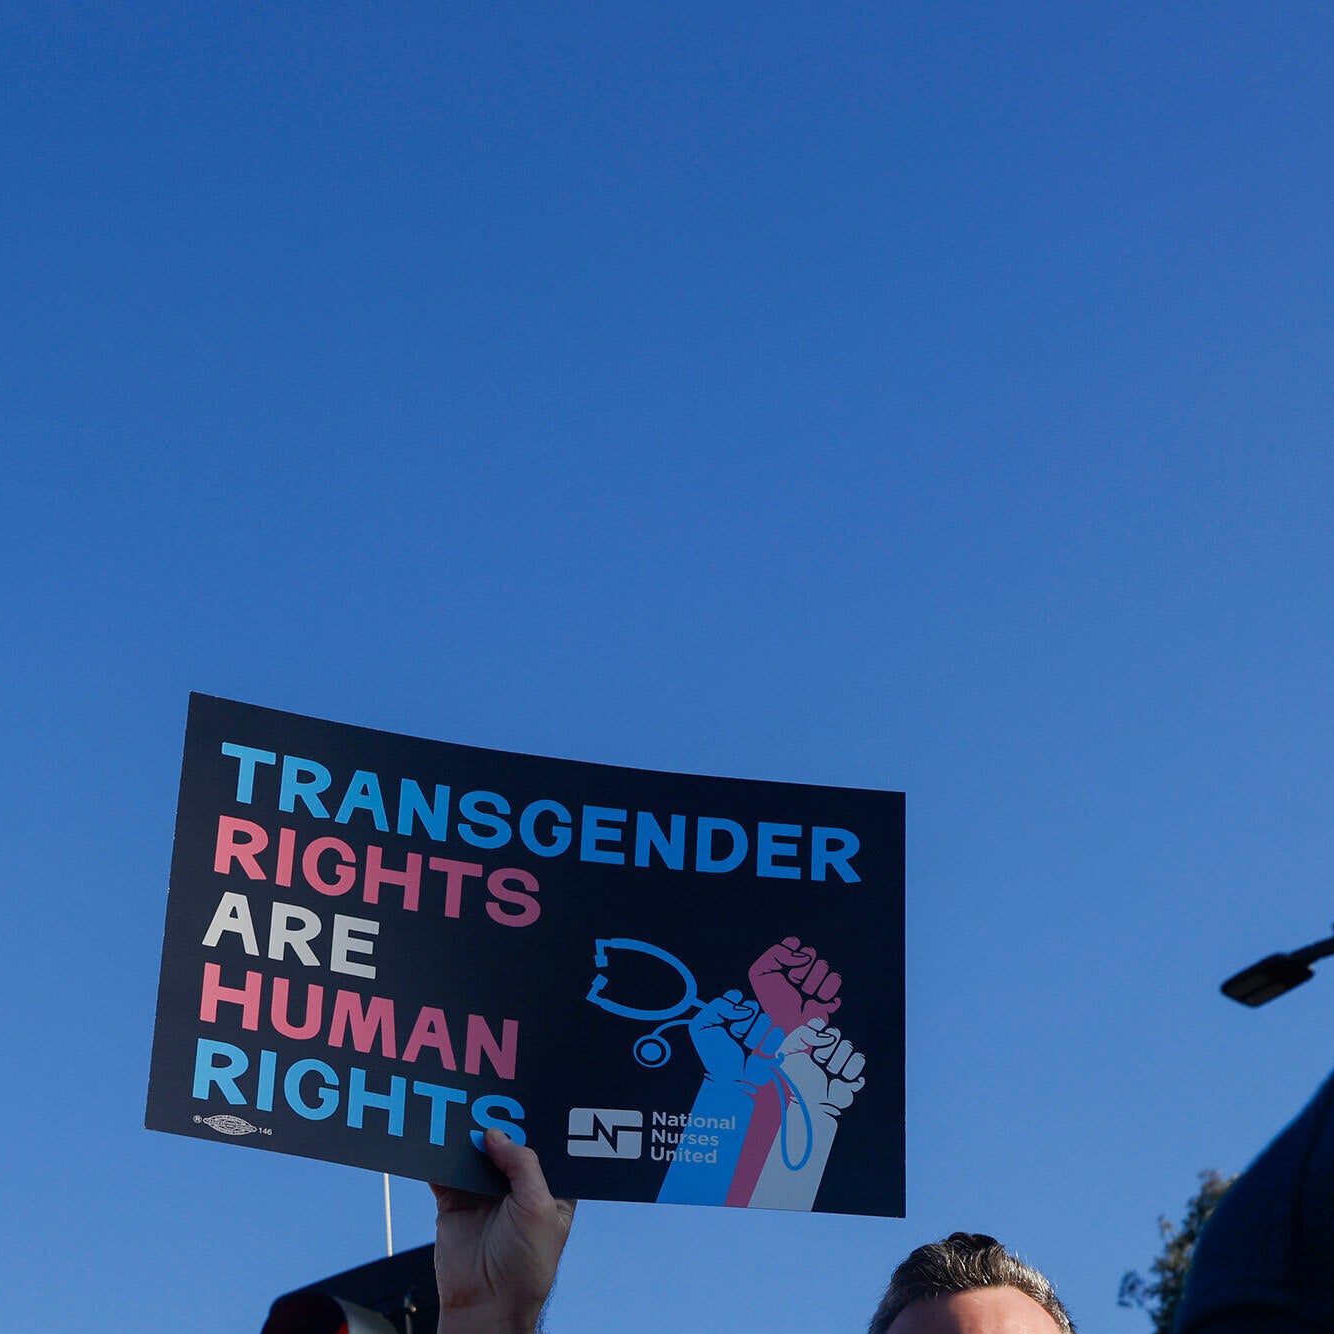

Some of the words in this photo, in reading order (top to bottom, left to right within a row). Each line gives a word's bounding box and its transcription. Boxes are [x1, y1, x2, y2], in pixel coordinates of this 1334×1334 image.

[220, 741, 862, 884] TRANSGENDER
[213, 815, 541, 928] RIGHTS
[202, 890, 380, 980] ARE
[199, 962, 519, 1080] HUMAN
[192, 1038, 526, 1152] RIGHTS
[258, 1126, 273, 1136] 146
[651, 1111, 736, 1130] National
[651, 1129, 719, 1146] Nurses
[650, 1146, 717, 1164] United
